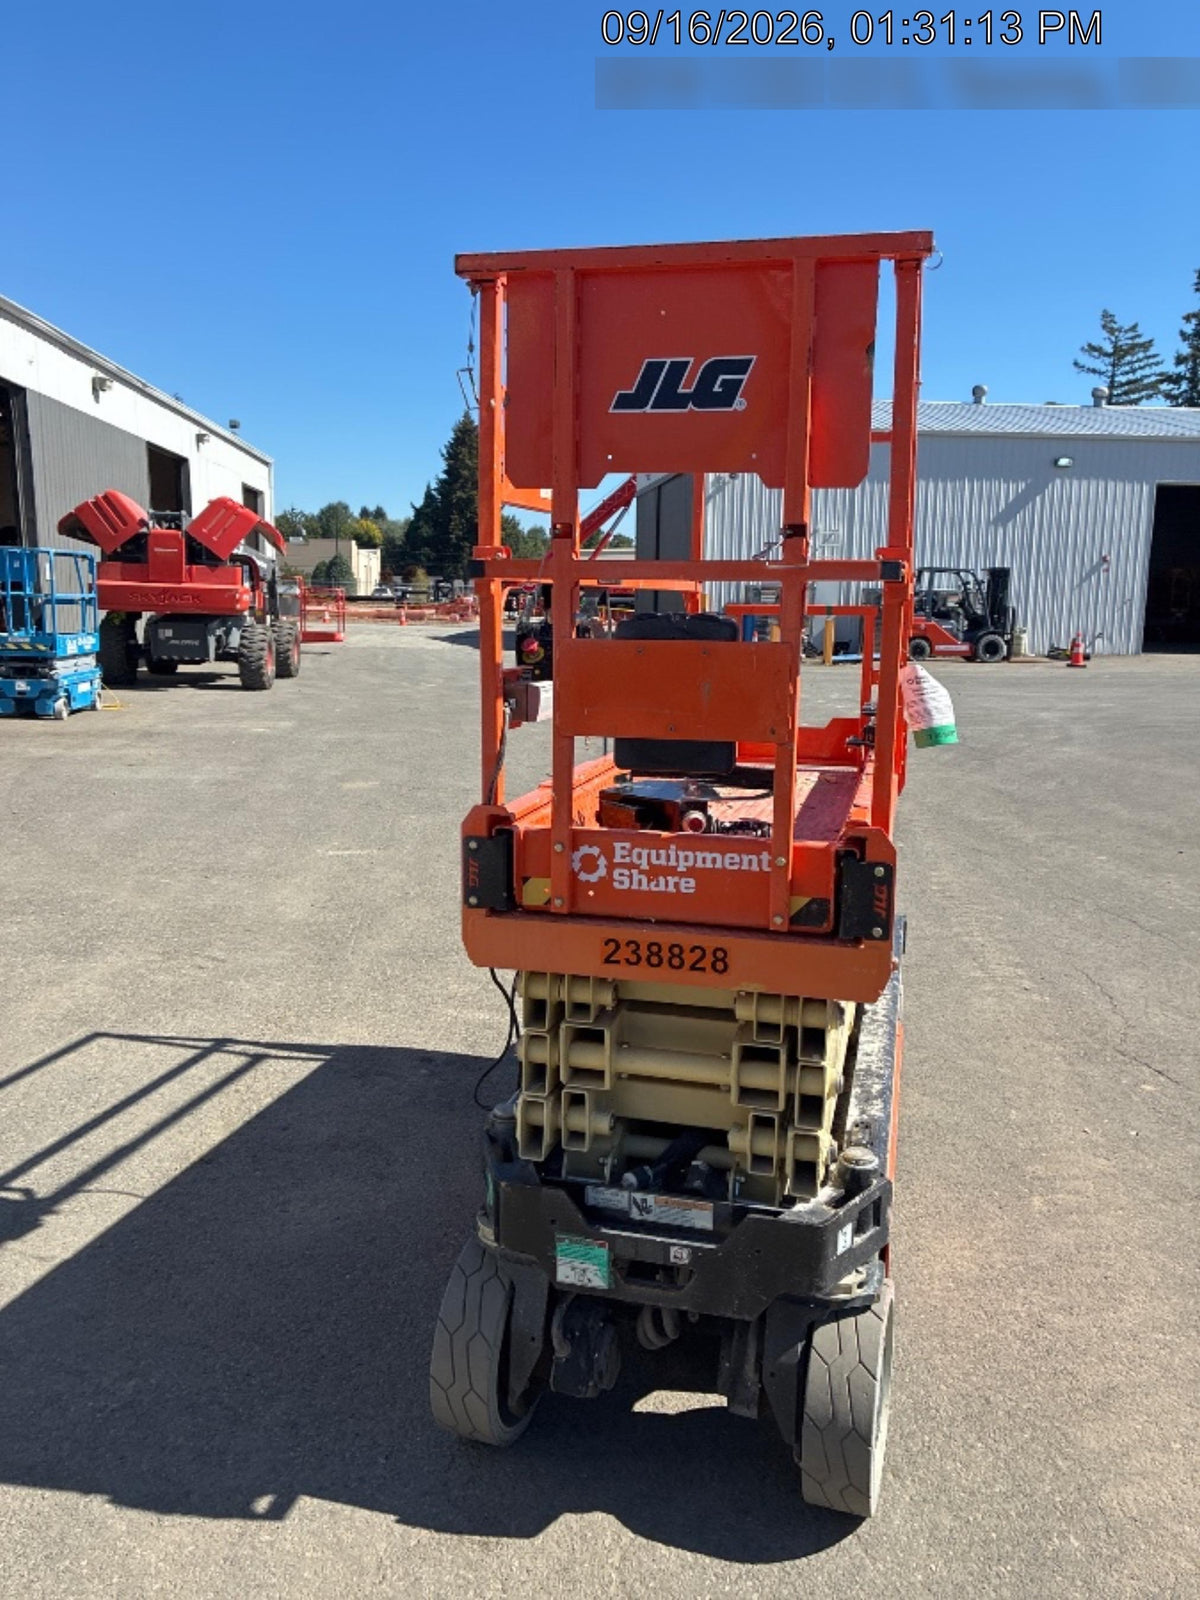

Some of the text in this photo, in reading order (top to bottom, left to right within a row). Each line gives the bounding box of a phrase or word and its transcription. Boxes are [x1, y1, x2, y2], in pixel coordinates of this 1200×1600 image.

[608, 355, 758, 414] JLG
[128, 590, 201, 605] SKYJACK
[612, 842, 772, 872] Equipment
[612, 868, 696, 893] Share
[603, 938, 730, 974] 238828
